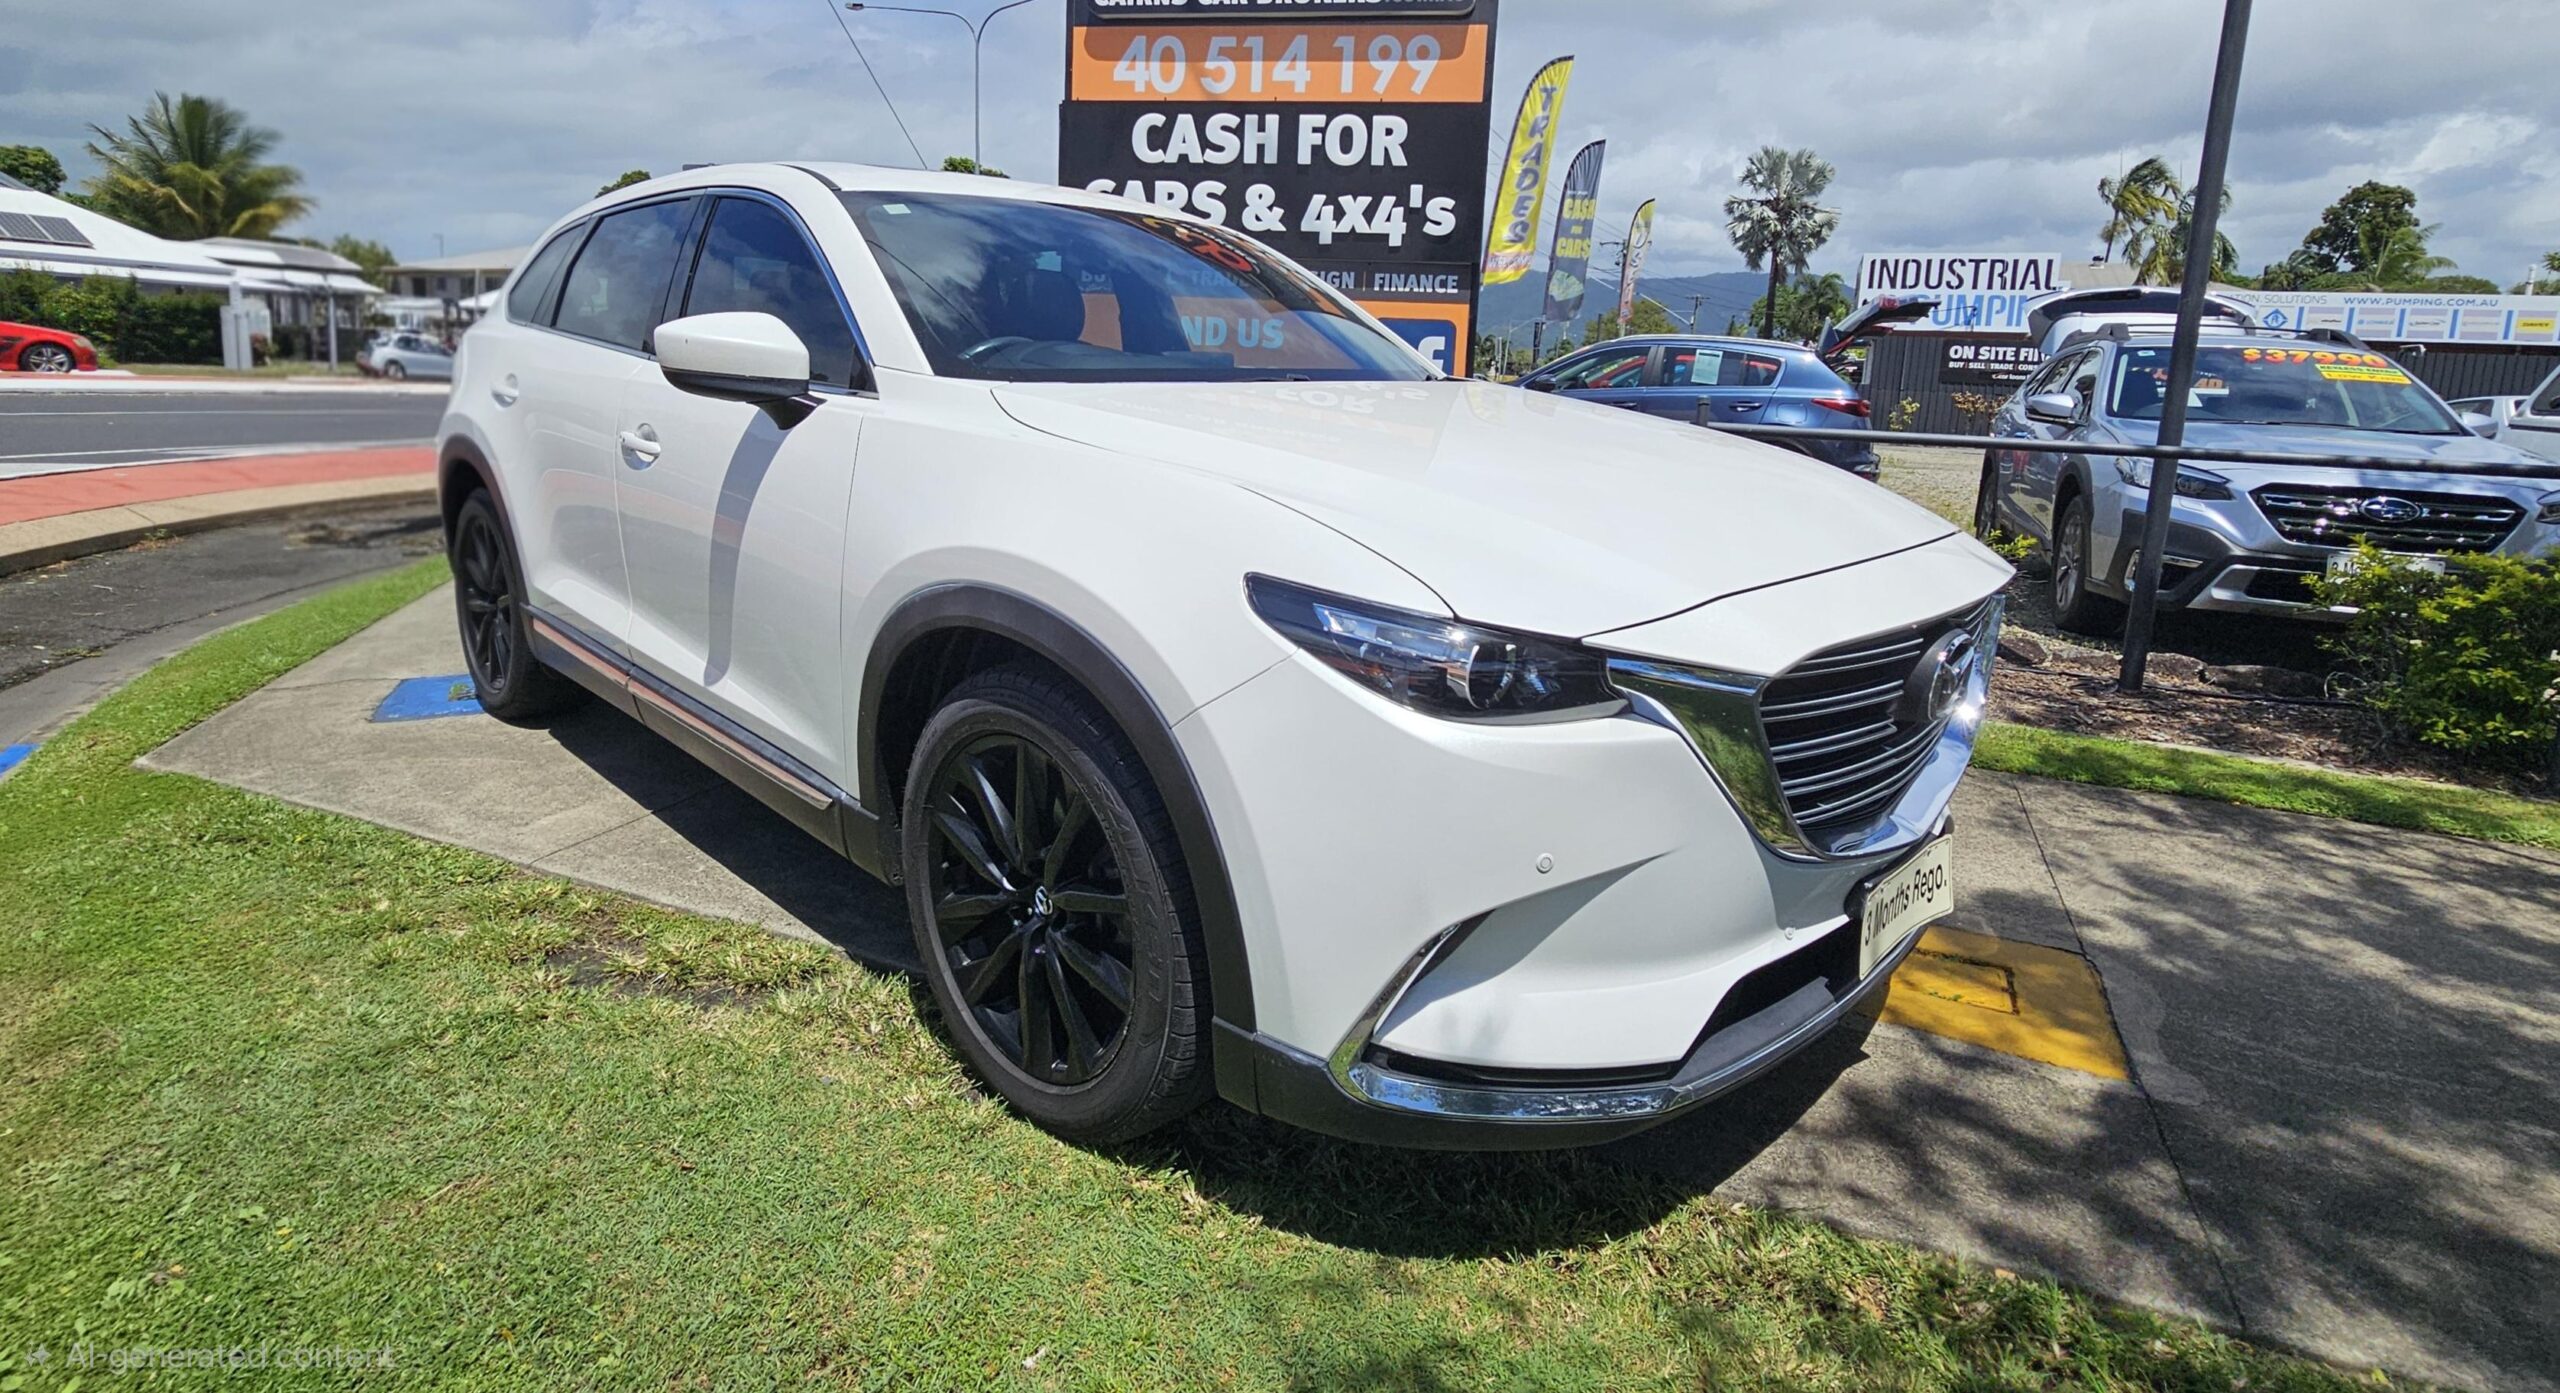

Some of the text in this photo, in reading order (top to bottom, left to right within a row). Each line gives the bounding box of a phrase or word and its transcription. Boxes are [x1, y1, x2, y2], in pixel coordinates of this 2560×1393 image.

[1113, 34, 1441, 95] 40 514 199
[1131, 113, 1408, 166] CASH FOR
[1504, 86, 1557, 244] TRADES
[1241, 183, 1287, 232] &
[1374, 273, 1459, 294] FINANCE
[1867, 258, 2060, 290] INDUSTRIAL
[2265, 295, 2328, 305] SOLUTIONS
[2344, 296, 2499, 308] WWW.PUMPING.COM.AU
[1238, 318, 1285, 349] US
[1948, 361, 1965, 369] BUY
[1968, 362, 1986, 370] SELL
[1990, 363, 2013, 371] TRADE
[1949, 345, 1975, 359] ON
[1978, 346, 2017, 361] SITE
[1864, 863, 1948, 946] 3 Months Rego.
